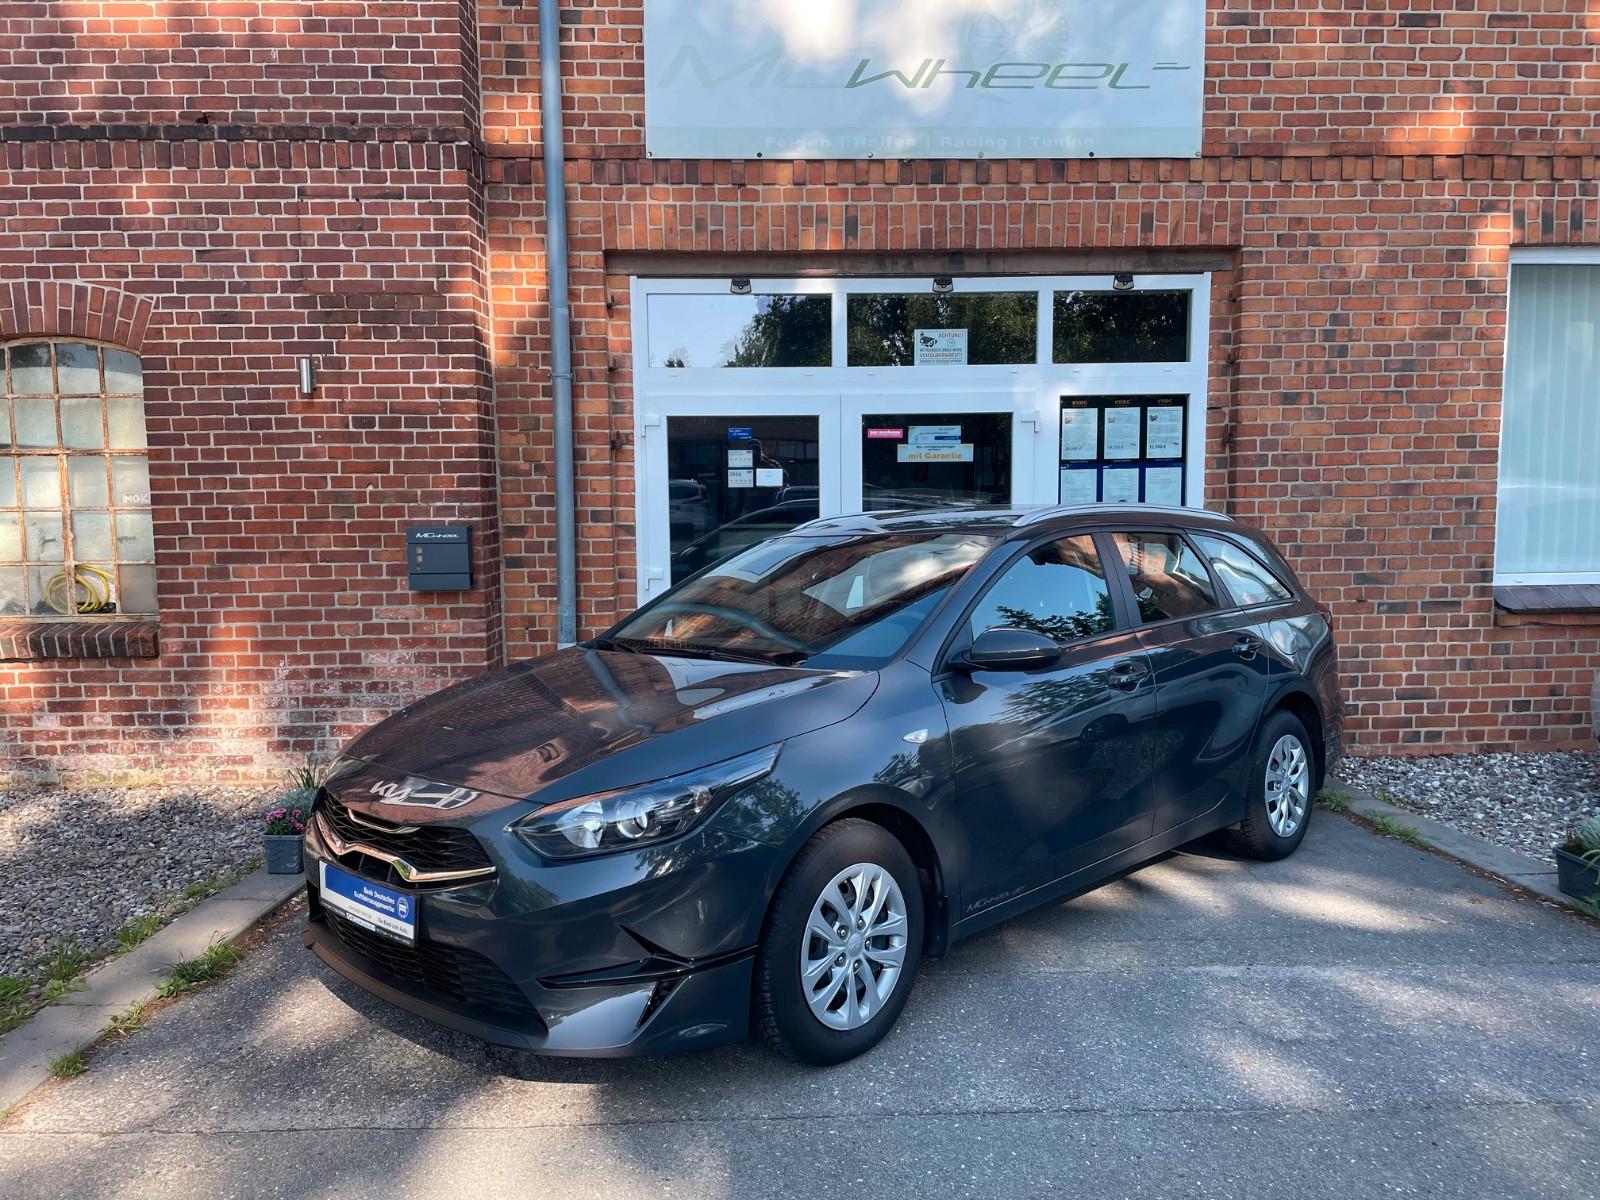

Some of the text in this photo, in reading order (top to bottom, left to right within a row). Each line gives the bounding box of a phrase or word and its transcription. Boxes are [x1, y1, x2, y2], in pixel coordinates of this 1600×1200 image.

[765, 136, 1096, 150] Felgen Reifen Racing Tuning
[908, 451, 962, 460] mit Garantie
